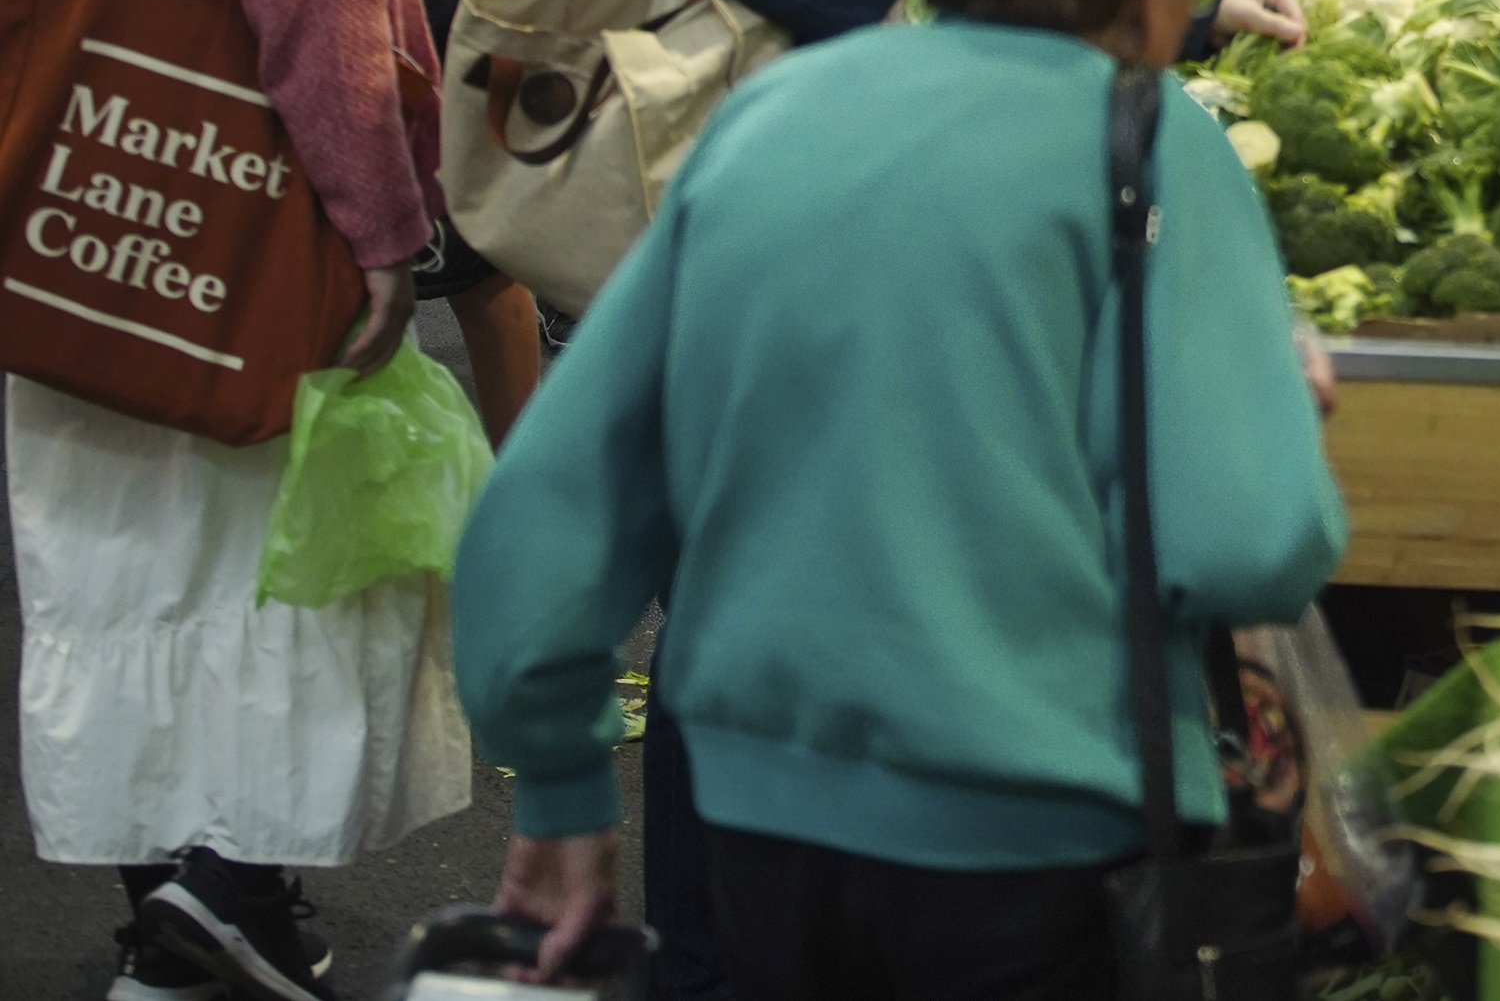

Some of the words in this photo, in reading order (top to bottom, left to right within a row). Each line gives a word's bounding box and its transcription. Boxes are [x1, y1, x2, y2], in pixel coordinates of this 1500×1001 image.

[40, 143, 203, 238] Lane
[59, 83, 292, 200] Market
[25, 206, 228, 313] Coffee
